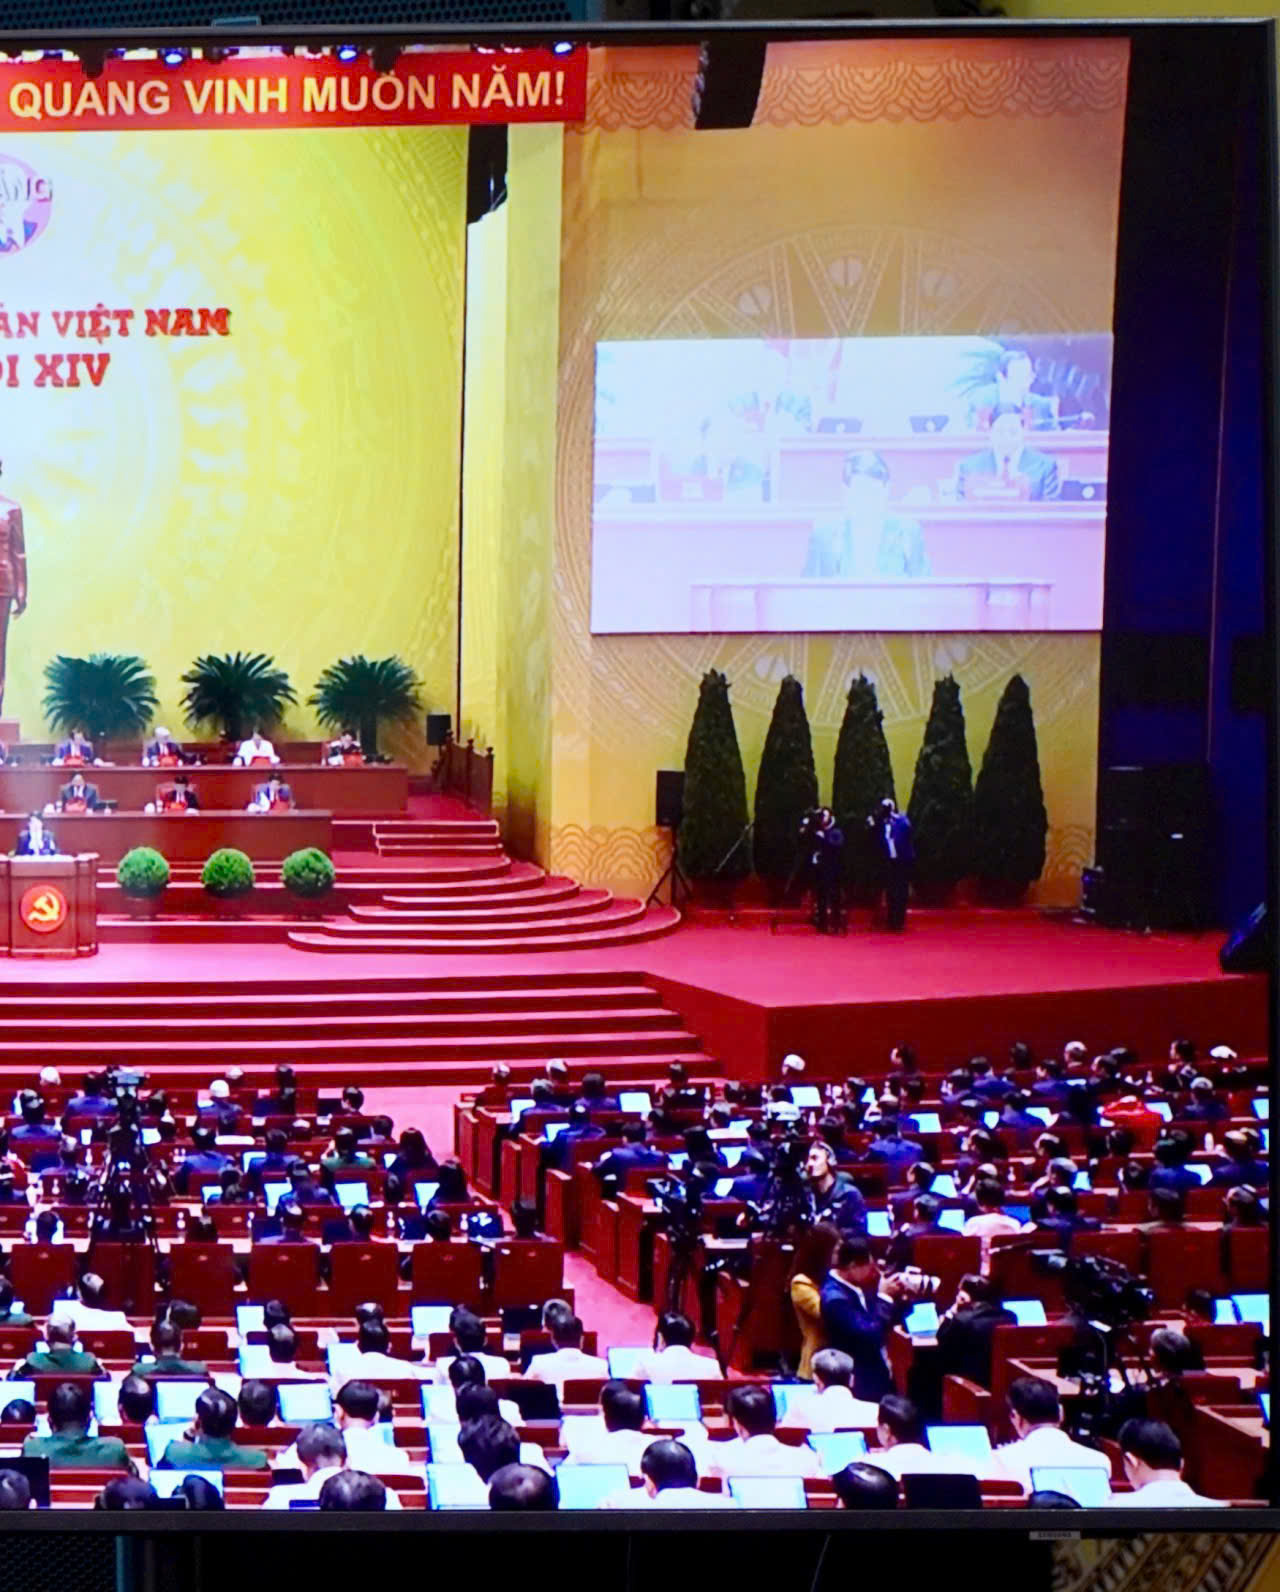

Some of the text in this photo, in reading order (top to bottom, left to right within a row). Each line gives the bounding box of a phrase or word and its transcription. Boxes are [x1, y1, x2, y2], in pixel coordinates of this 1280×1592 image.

[9, 80, 171, 121] QUANG
[184, 77, 288, 115] VINH
[451, 64, 566, 110] NĂM!
[52, 303, 134, 345] VIỆT
[145, 307, 233, 338] NAM
[34, 353, 111, 389] XIV
